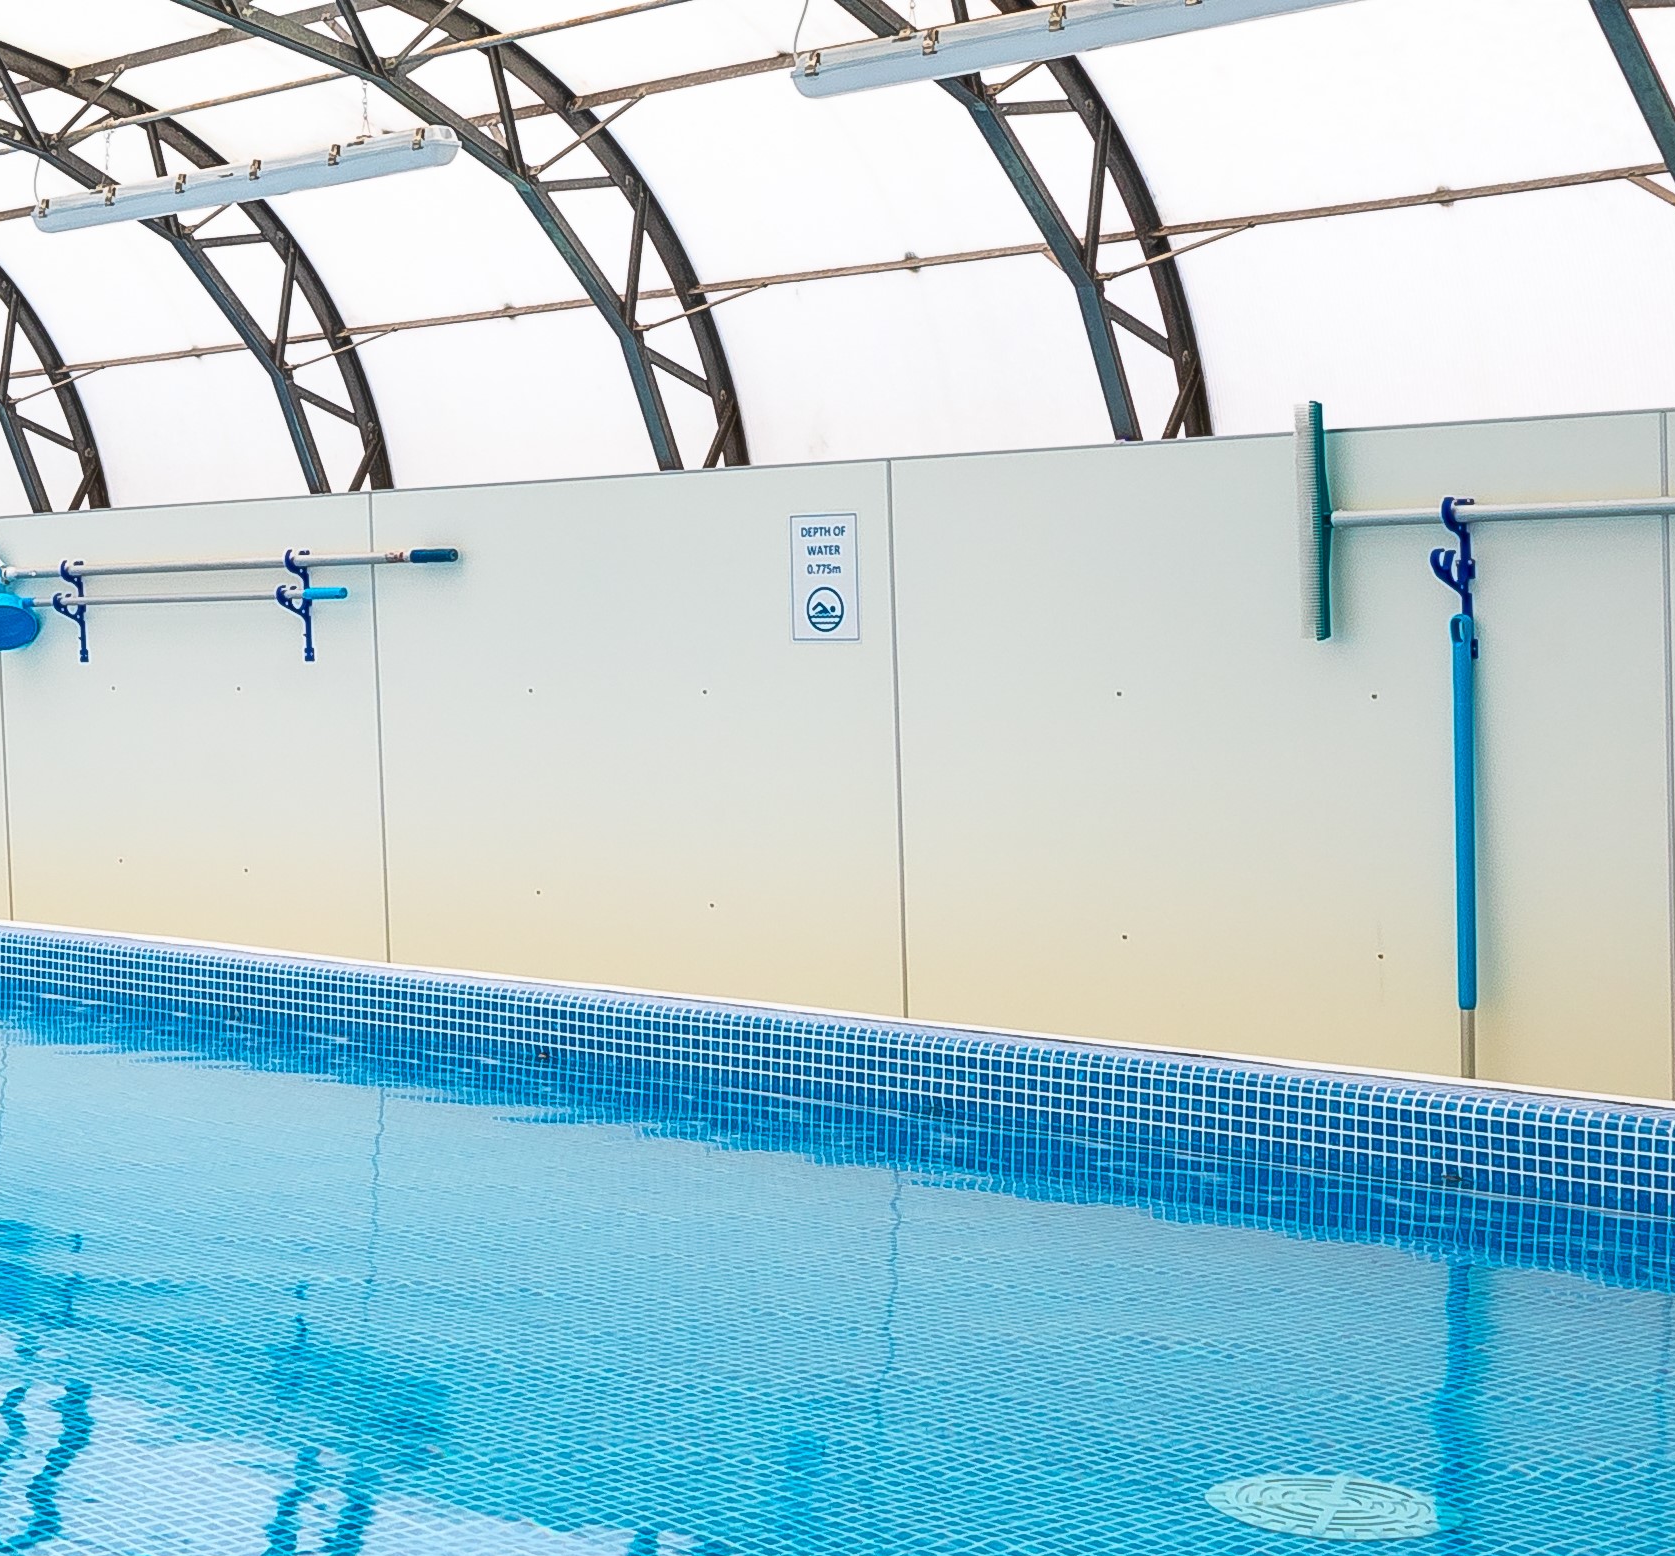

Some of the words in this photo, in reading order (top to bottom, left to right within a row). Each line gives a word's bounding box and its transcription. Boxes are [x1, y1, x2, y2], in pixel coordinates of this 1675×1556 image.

[800, 526, 831, 538] DEPTH
[833, 525, 846, 537] OF
[806, 544, 841, 556] WATER
[806, 563, 842, 575] 0.775m
